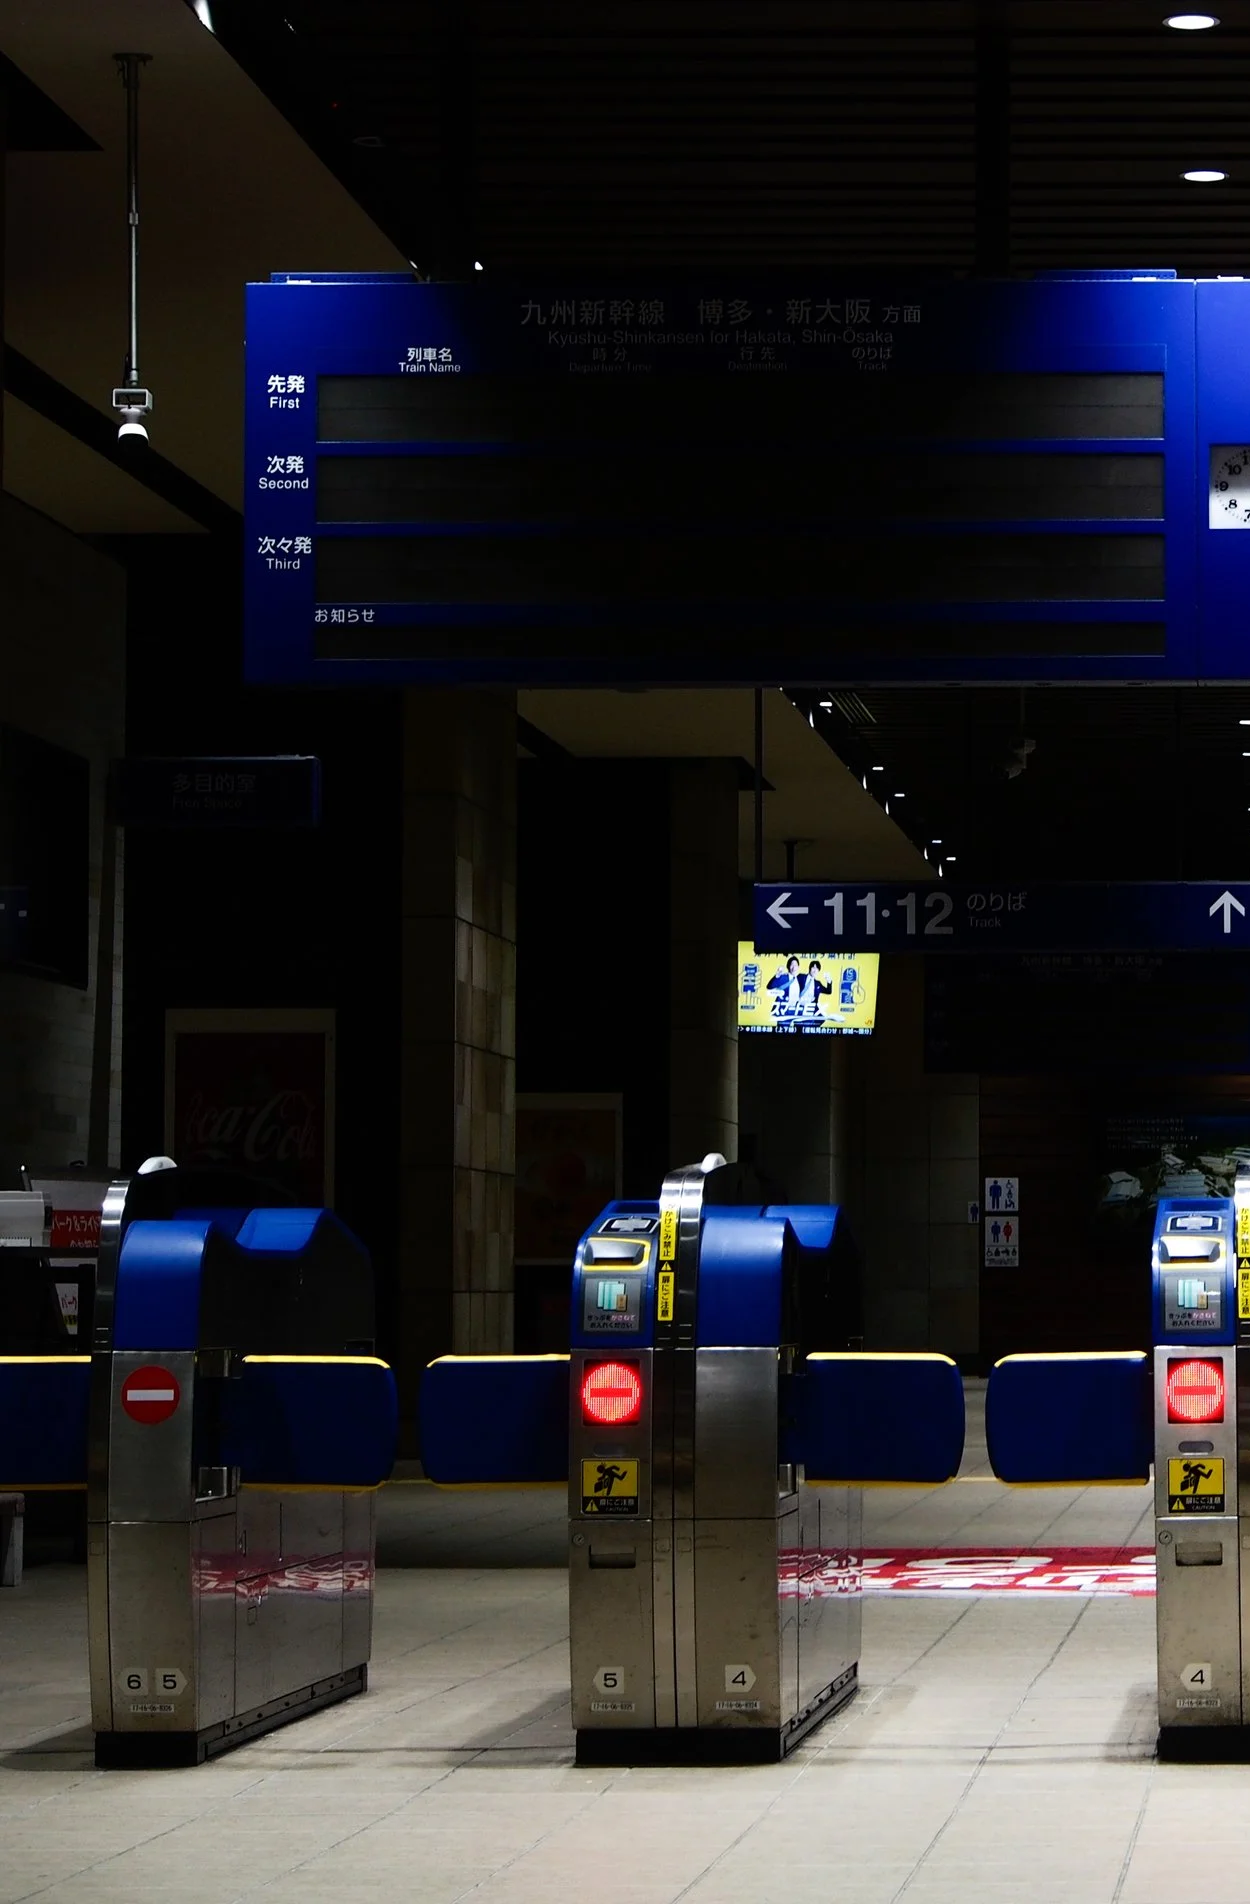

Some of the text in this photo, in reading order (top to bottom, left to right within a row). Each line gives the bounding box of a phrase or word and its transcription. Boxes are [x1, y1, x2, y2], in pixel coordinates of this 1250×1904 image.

[519, 296, 922, 327] 九州新幹線 博多・新大阪 方面
[710, 329, 729, 344] for
[406, 347, 453, 363] 列車名
[851, 345, 894, 361] のりば
[398, 361, 462, 373] Train Name
[266, 374, 305, 394] 先発
[269, 396, 301, 409] First
[266, 455, 304, 475] 次発
[1227, 464, 1242, 476] 10
[258, 477, 309, 490] Second
[1219, 481, 1229, 491] 9
[1228, 499, 1238, 509] 8
[257, 536, 313, 556] 次々発
[265, 557, 301, 571] Third
[313, 608, 376, 624] お知らせ
[171, 772, 258, 794] 多目的室
[966, 891, 1028, 913] のりば
[966, 915, 1002, 929] Track
[663, 1210, 674, 1258] かけこみ禁止
[1240, 1207, 1250, 1255] かけこみ禁止
[659, 1275, 671, 1318] 扉にご注意
[1241, 1272, 1250, 1315] 扉にご注意
[127, 1674, 142, 1690] 6
[162, 1674, 177, 1690] 5
[603, 1672, 618, 1688] 5
[732, 1670, 747, 1686] 4
[1190, 1669, 1205, 1685] 4
